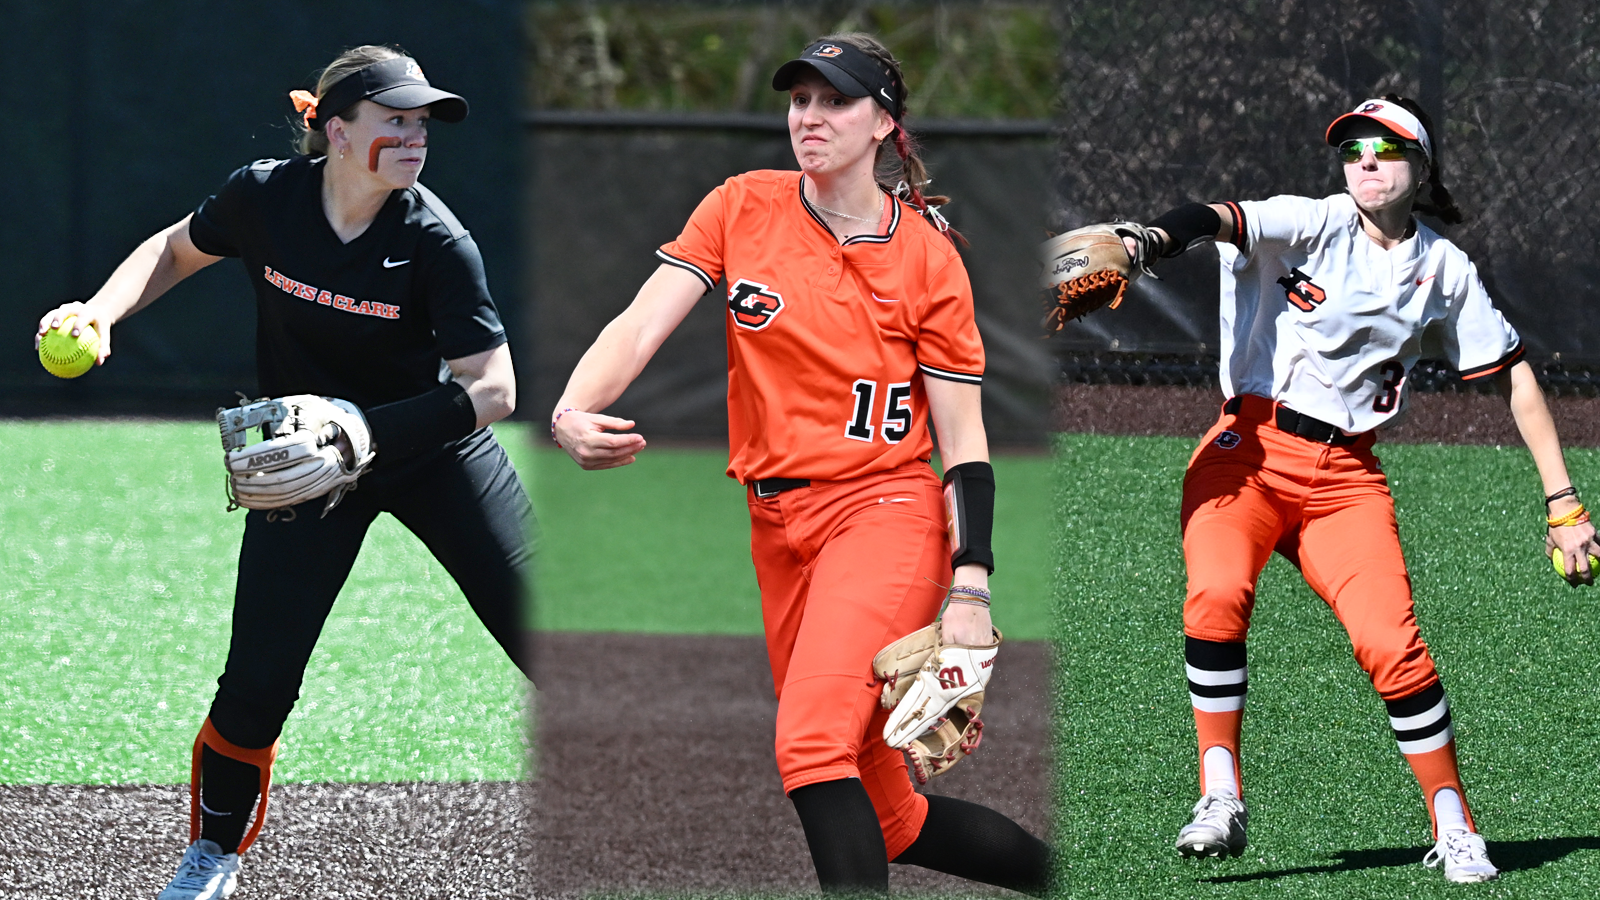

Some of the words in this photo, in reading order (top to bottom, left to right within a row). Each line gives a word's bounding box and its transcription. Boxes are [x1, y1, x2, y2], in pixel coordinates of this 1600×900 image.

[264, 265, 317, 301] LEWIS
[317, 289, 332, 306] &
[333, 294, 400, 319] CLARK
[844, 378, 912, 444] 15
[1372, 360, 1405, 414] 3
[247, 449, 289, 468] A2000
